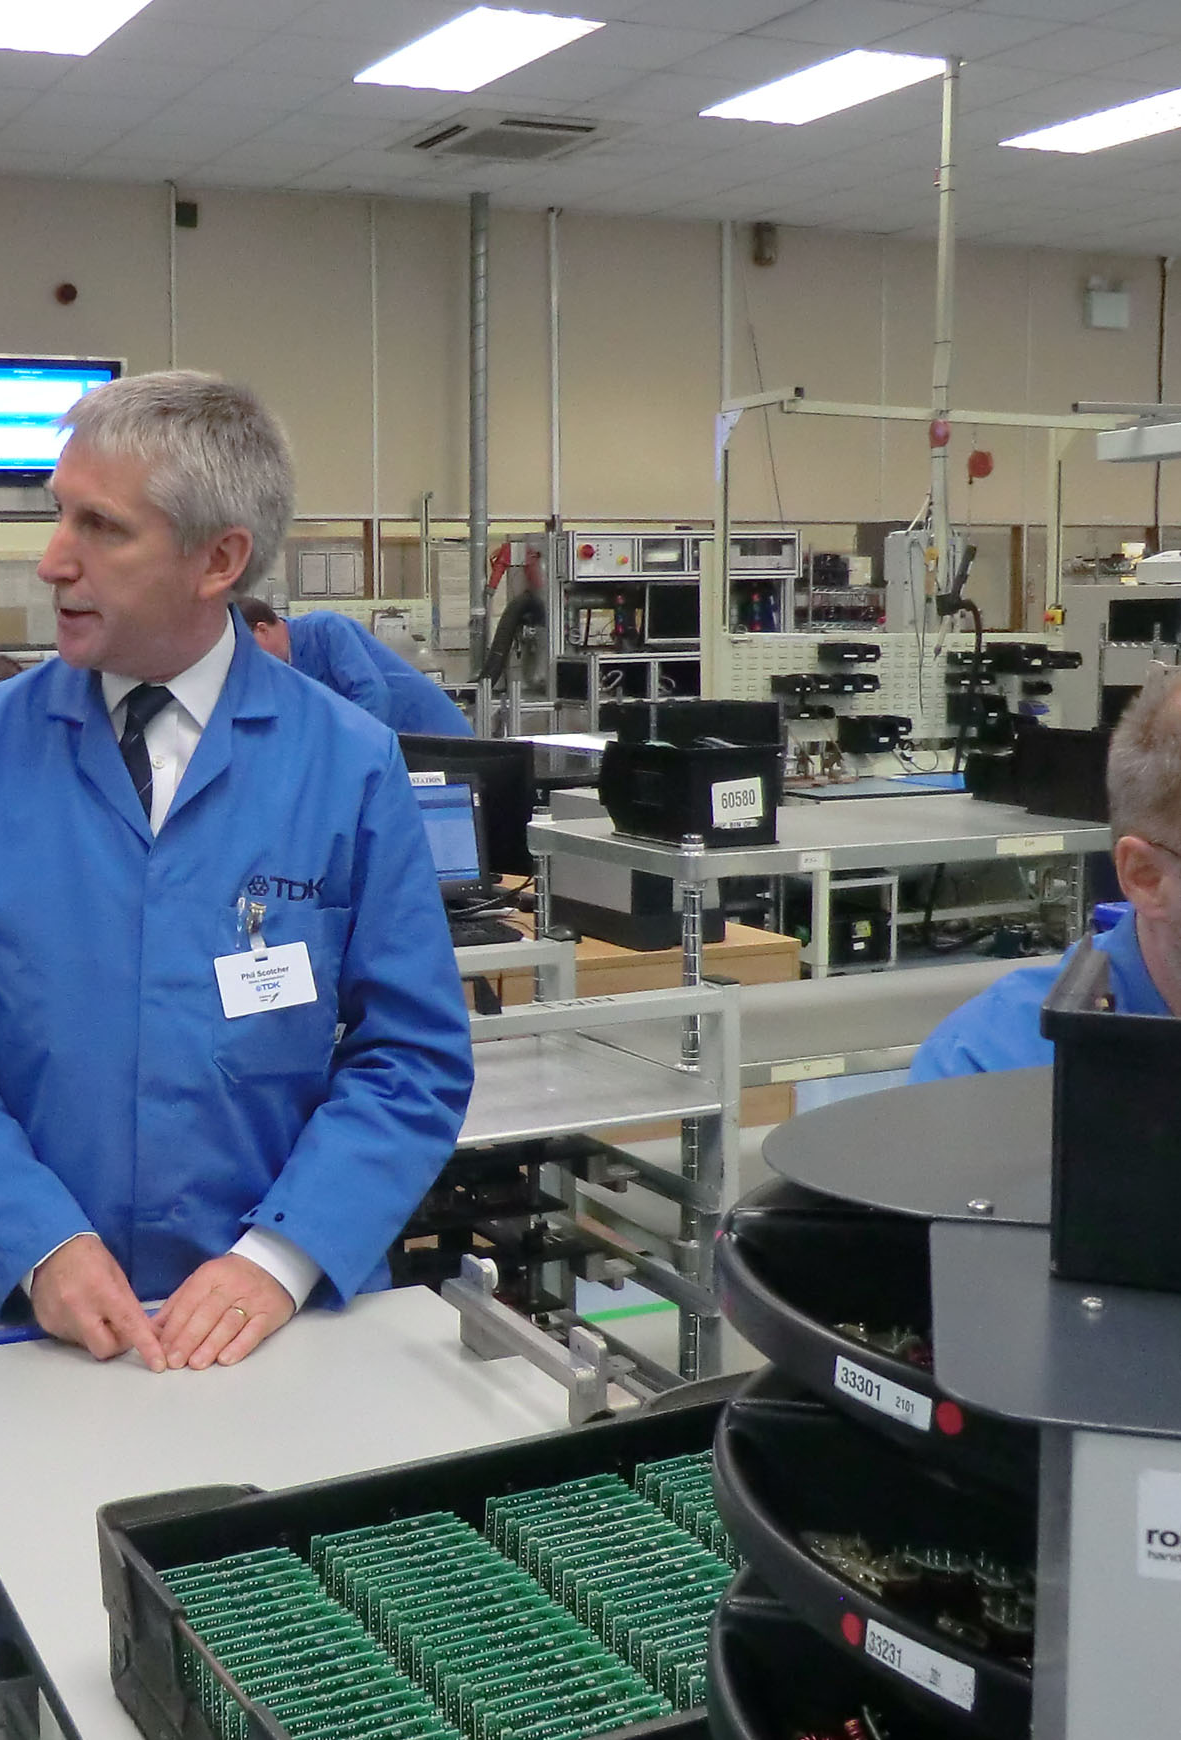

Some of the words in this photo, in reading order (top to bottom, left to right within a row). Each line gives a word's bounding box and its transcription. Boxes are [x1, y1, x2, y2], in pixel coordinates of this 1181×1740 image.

[411, 776, 442, 784] STATION
[721, 788, 756, 809] 60580
[269, 875, 325, 901] TDK
[241, 971, 255, 980] Phil
[256, 966, 289, 977] Scotcher
[262, 981, 281, 991] TDK
[840, 1367, 881, 1401] 33301
[895, 1396, 915, 1414] 2101
[867, 1630, 902, 1668] 33231
